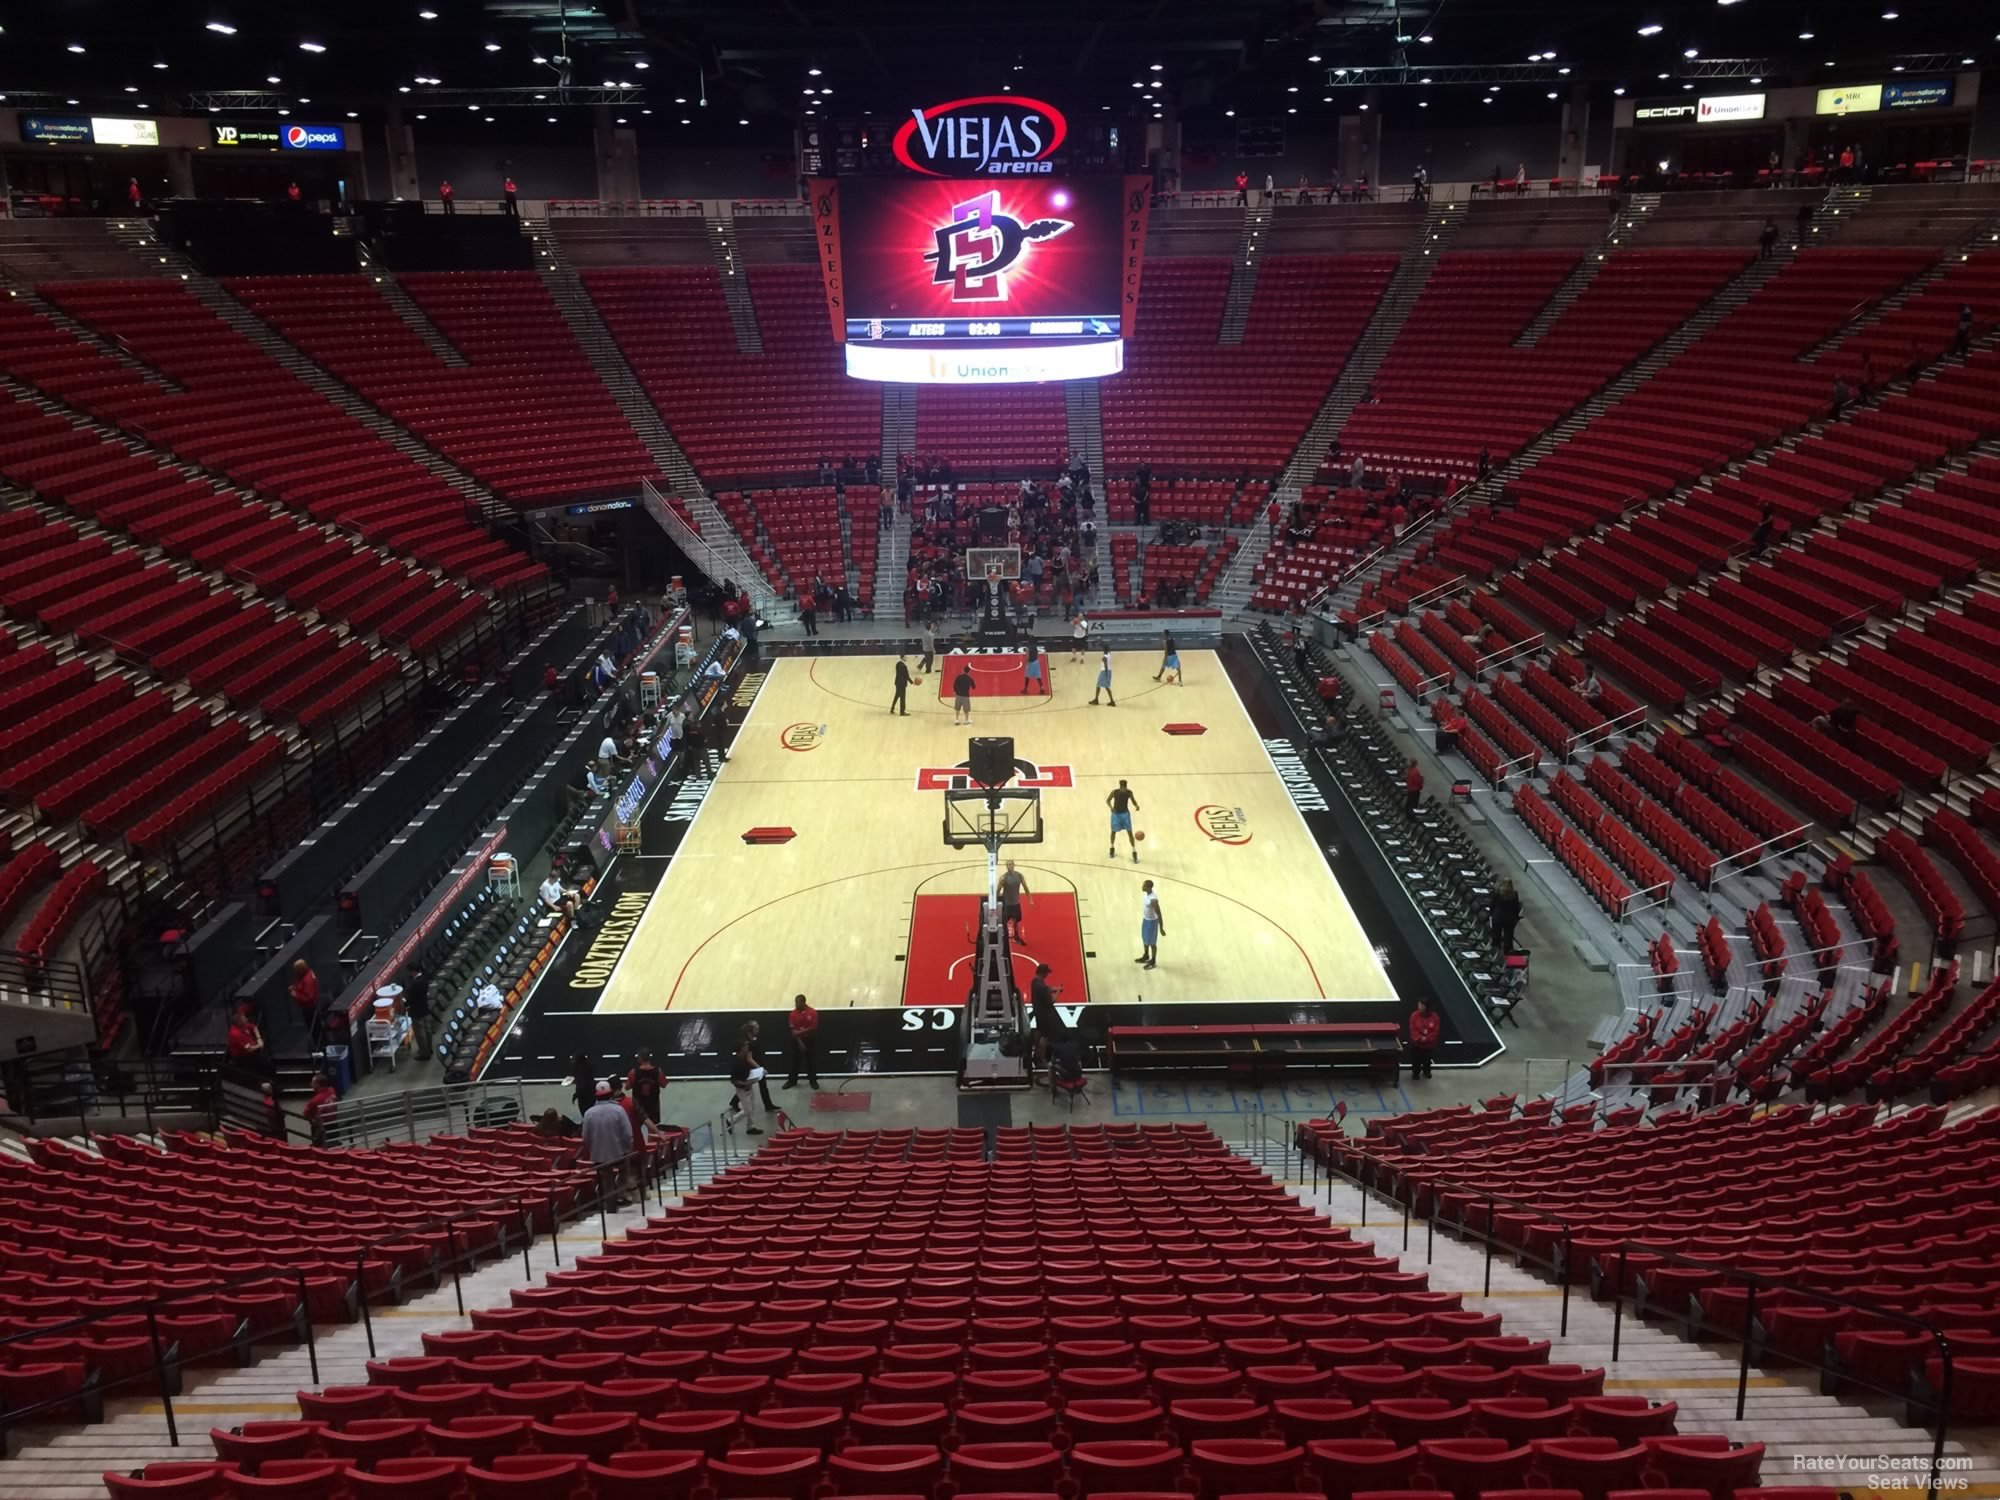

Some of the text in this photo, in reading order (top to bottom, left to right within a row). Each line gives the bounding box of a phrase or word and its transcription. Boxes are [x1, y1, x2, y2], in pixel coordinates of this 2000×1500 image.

[216, 126, 238, 141] yp
[308, 132, 338, 144] pepsi
[911, 108, 1042, 172] VIEJAS
[988, 160, 1053, 174] arena
[1262, 738, 1330, 812] SAN DIEGO STATE
[663, 802, 699, 822] SAN
[569, 891, 653, 989] GOAZTECS.COM
